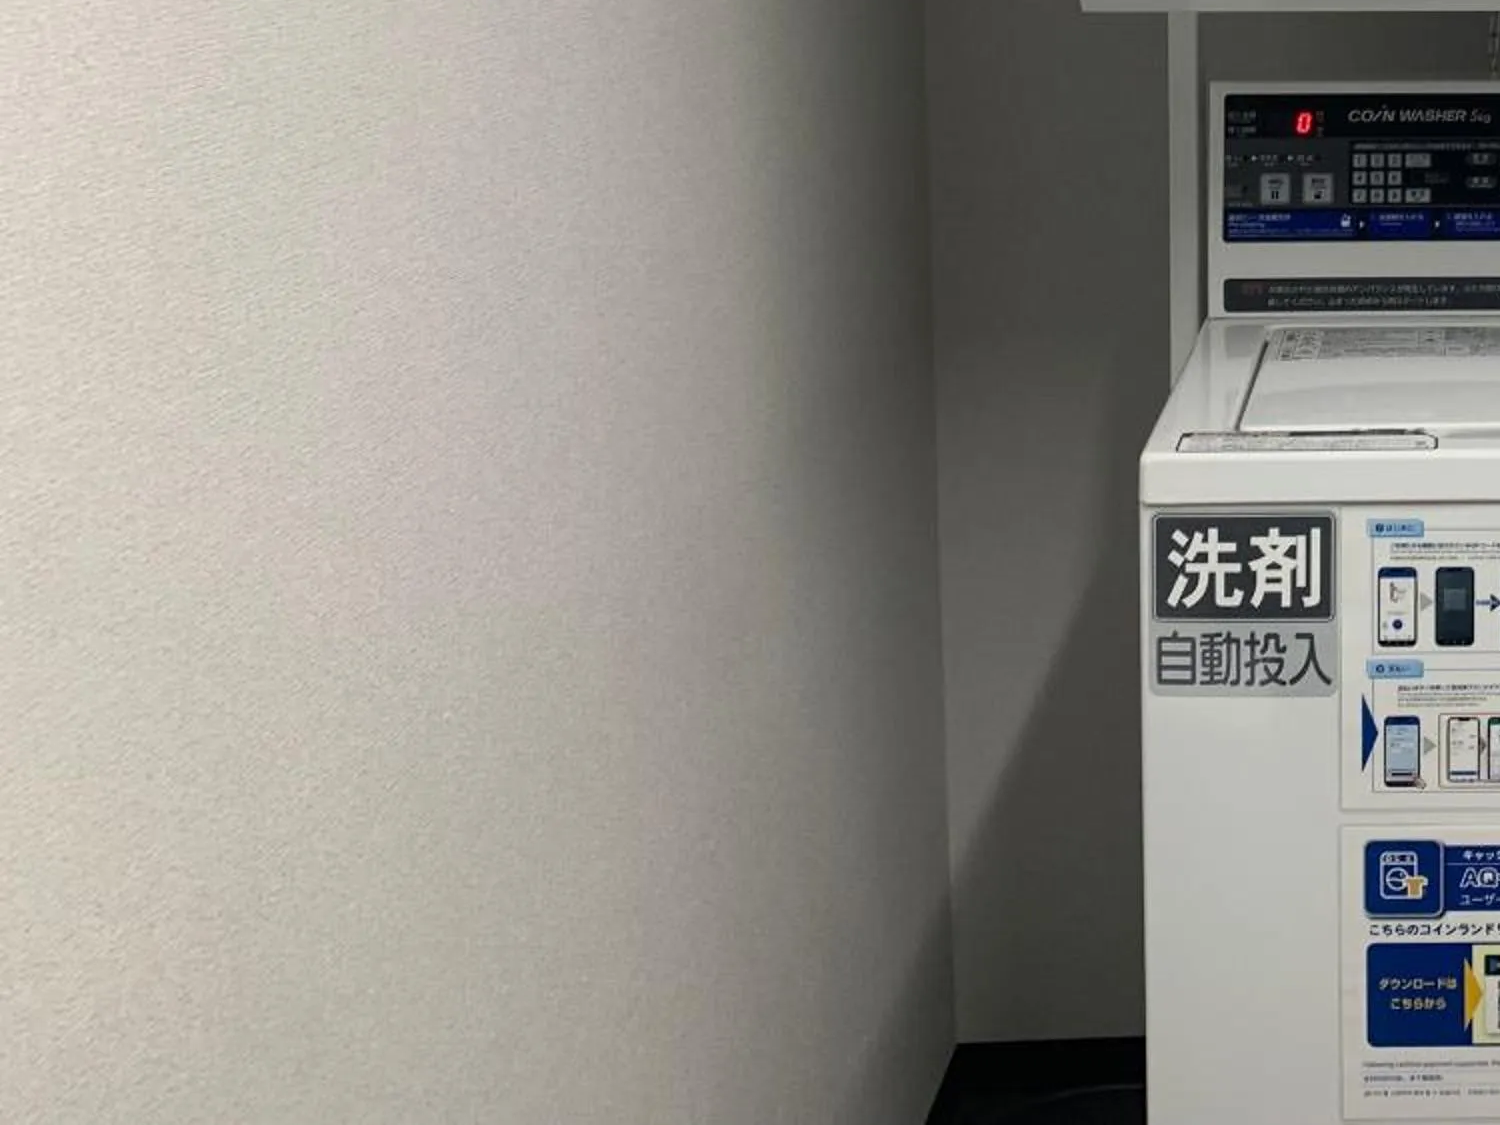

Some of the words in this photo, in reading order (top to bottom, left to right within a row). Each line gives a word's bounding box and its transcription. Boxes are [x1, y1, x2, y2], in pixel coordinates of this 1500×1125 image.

[1296, 111, 1313, 134] 0
[1399, 109, 1466, 123] WASHER
[1166, 527, 1321, 609] 洗剤
[1157, 630, 1332, 687] 自動投入
[1378, 977, 1457, 990] ダウンロードは
[1389, 997, 1447, 1010] こちらから
